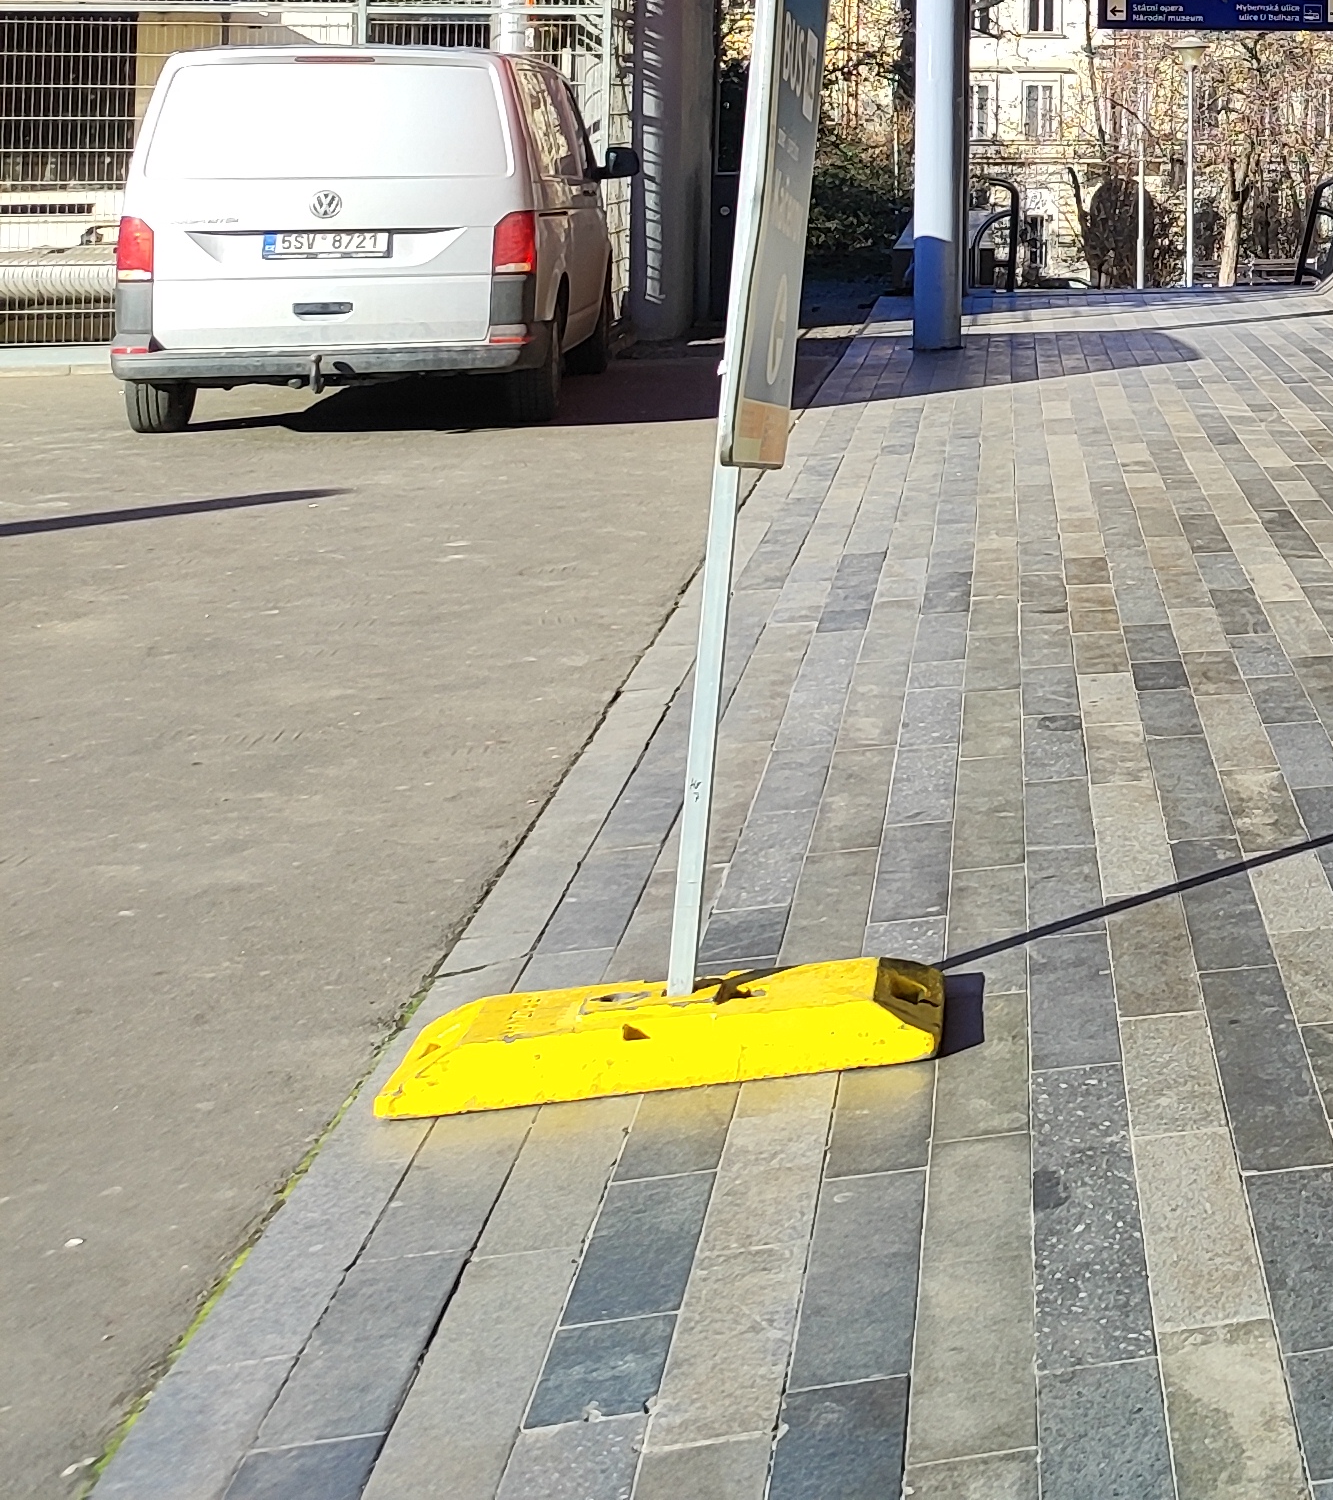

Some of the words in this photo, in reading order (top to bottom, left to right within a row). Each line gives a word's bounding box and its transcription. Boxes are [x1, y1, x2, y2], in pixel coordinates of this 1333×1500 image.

[1132, 2, 1159, 11] Státní
[1132, 13, 1167, 21] Národní
[1238, 13, 1259, 21] ulice
[1260, 13, 1267, 21] U
[783, 10, 805, 98] BUS
[281, 233, 317, 250] 5SV
[331, 232, 379, 250] 8721
